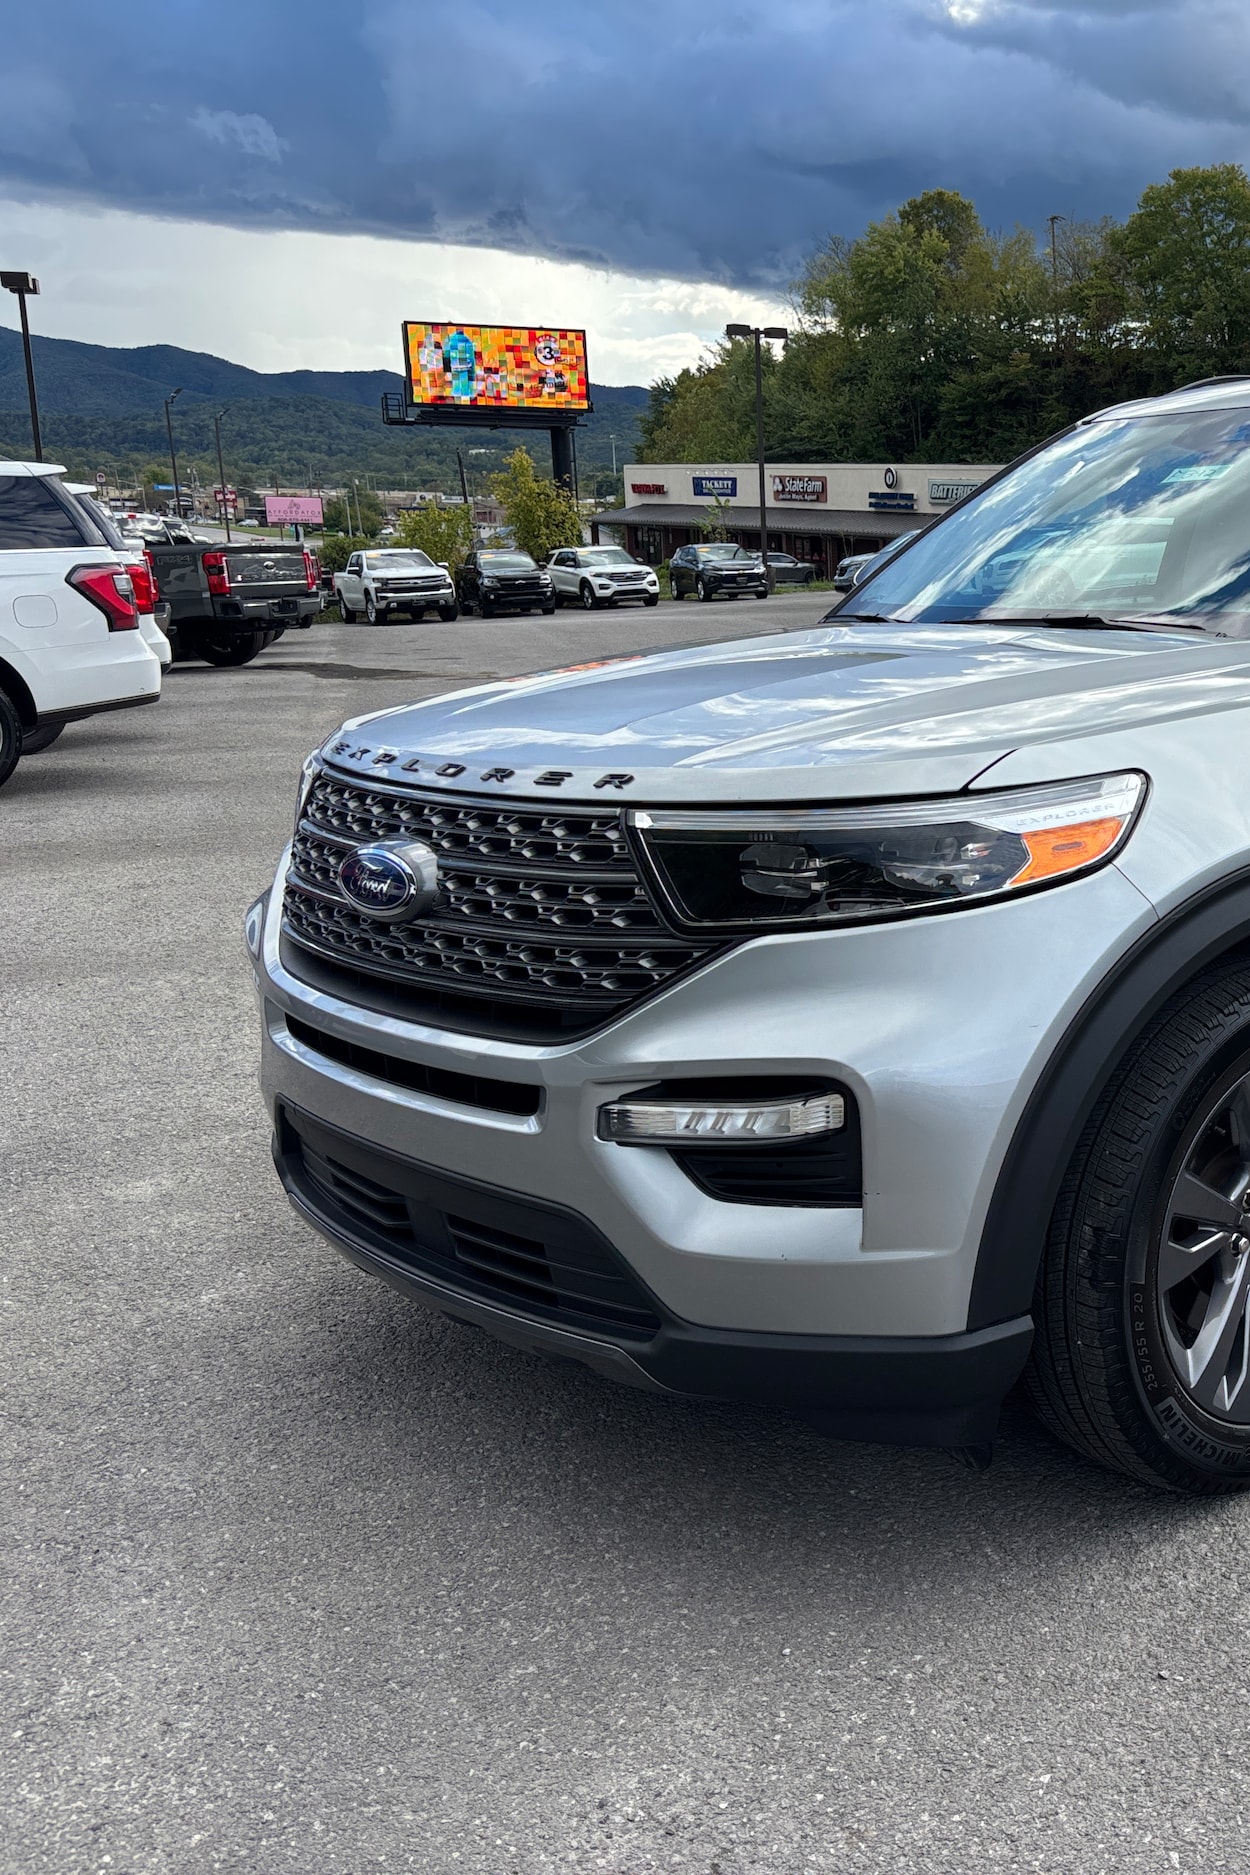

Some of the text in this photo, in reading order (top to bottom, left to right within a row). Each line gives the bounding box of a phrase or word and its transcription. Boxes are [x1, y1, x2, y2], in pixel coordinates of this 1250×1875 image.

[930, 484, 979, 499] BATTERIE
[332, 741, 636, 790] EXPLORER
[1016, 803, 1115, 826] EXPLORER
[1133, 1292, 1144, 1314] 20
[1135, 1320, 1146, 1332] R
[1135, 1337, 1159, 1391] 255/55
[1160, 1403, 1243, 1467] MICHELIN
